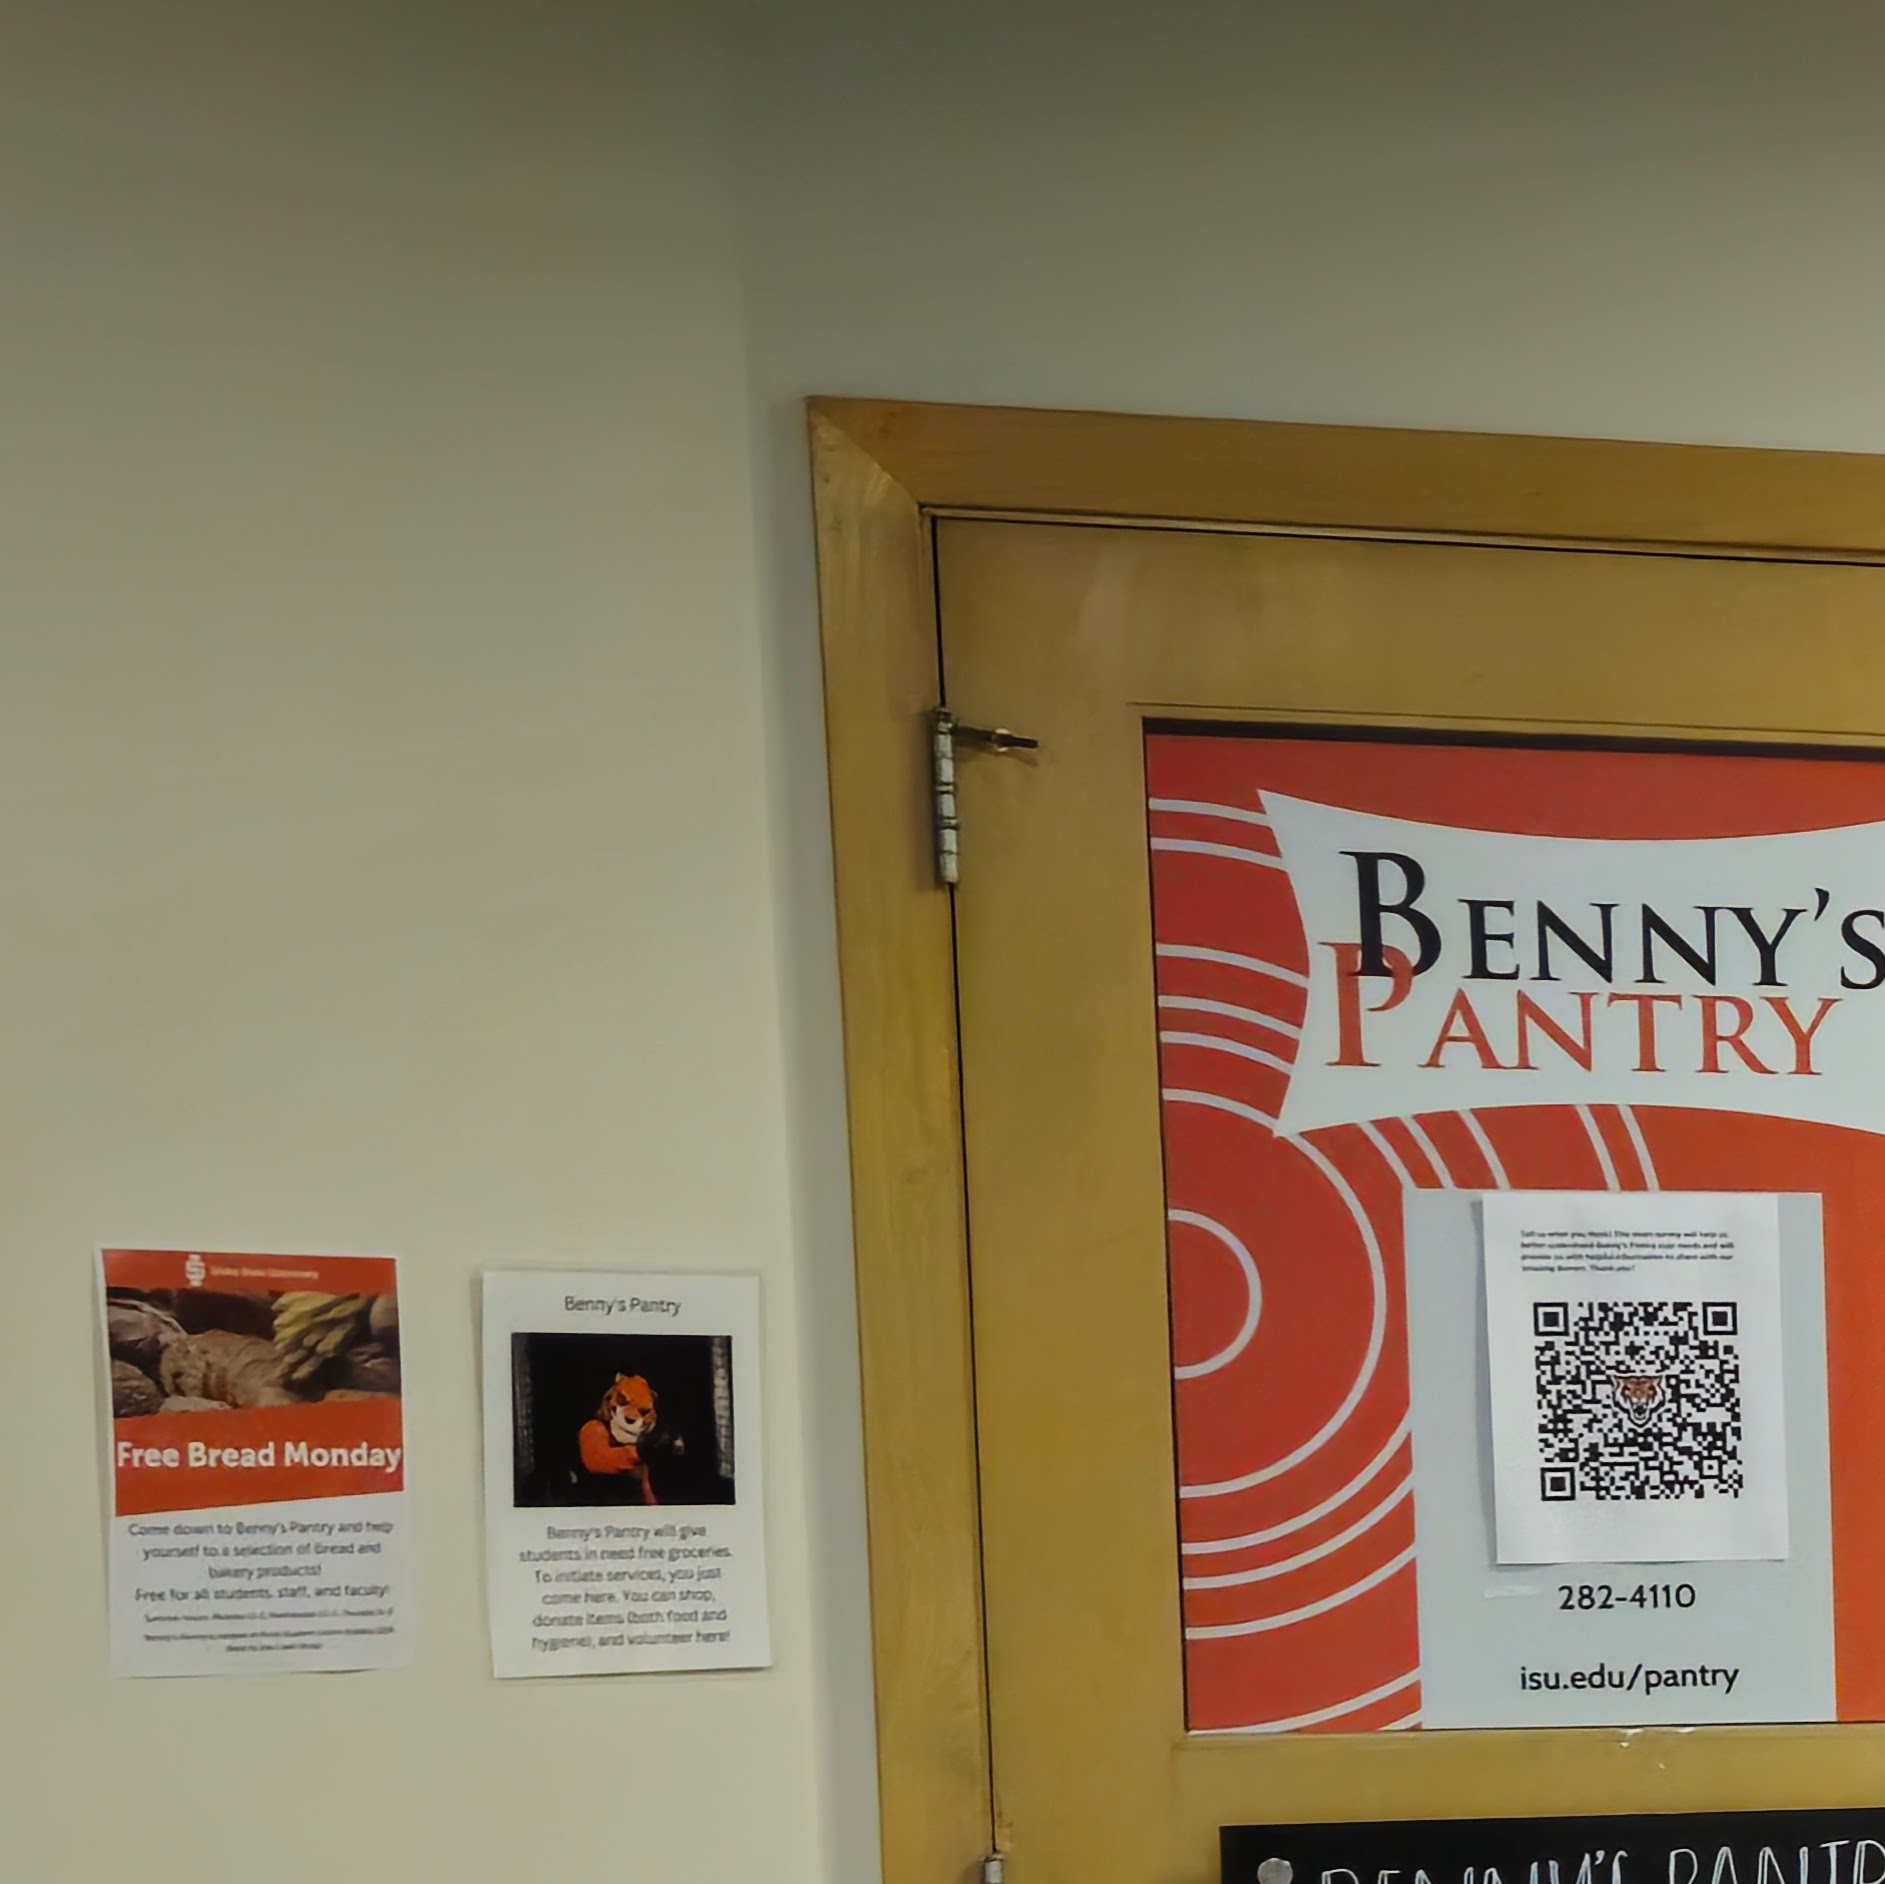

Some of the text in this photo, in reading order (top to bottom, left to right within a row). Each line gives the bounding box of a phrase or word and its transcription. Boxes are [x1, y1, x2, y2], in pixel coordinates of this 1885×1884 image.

[1317, 940, 1843, 1078] PANTRY
[564, 1295, 682, 1318] Benny's Pantry
[117, 1440, 402, 1473] Free Bread Monday
[1557, 1583, 1696, 1611] 282-4110
[1519, 1662, 1740, 1696] isu.edu/pantry
